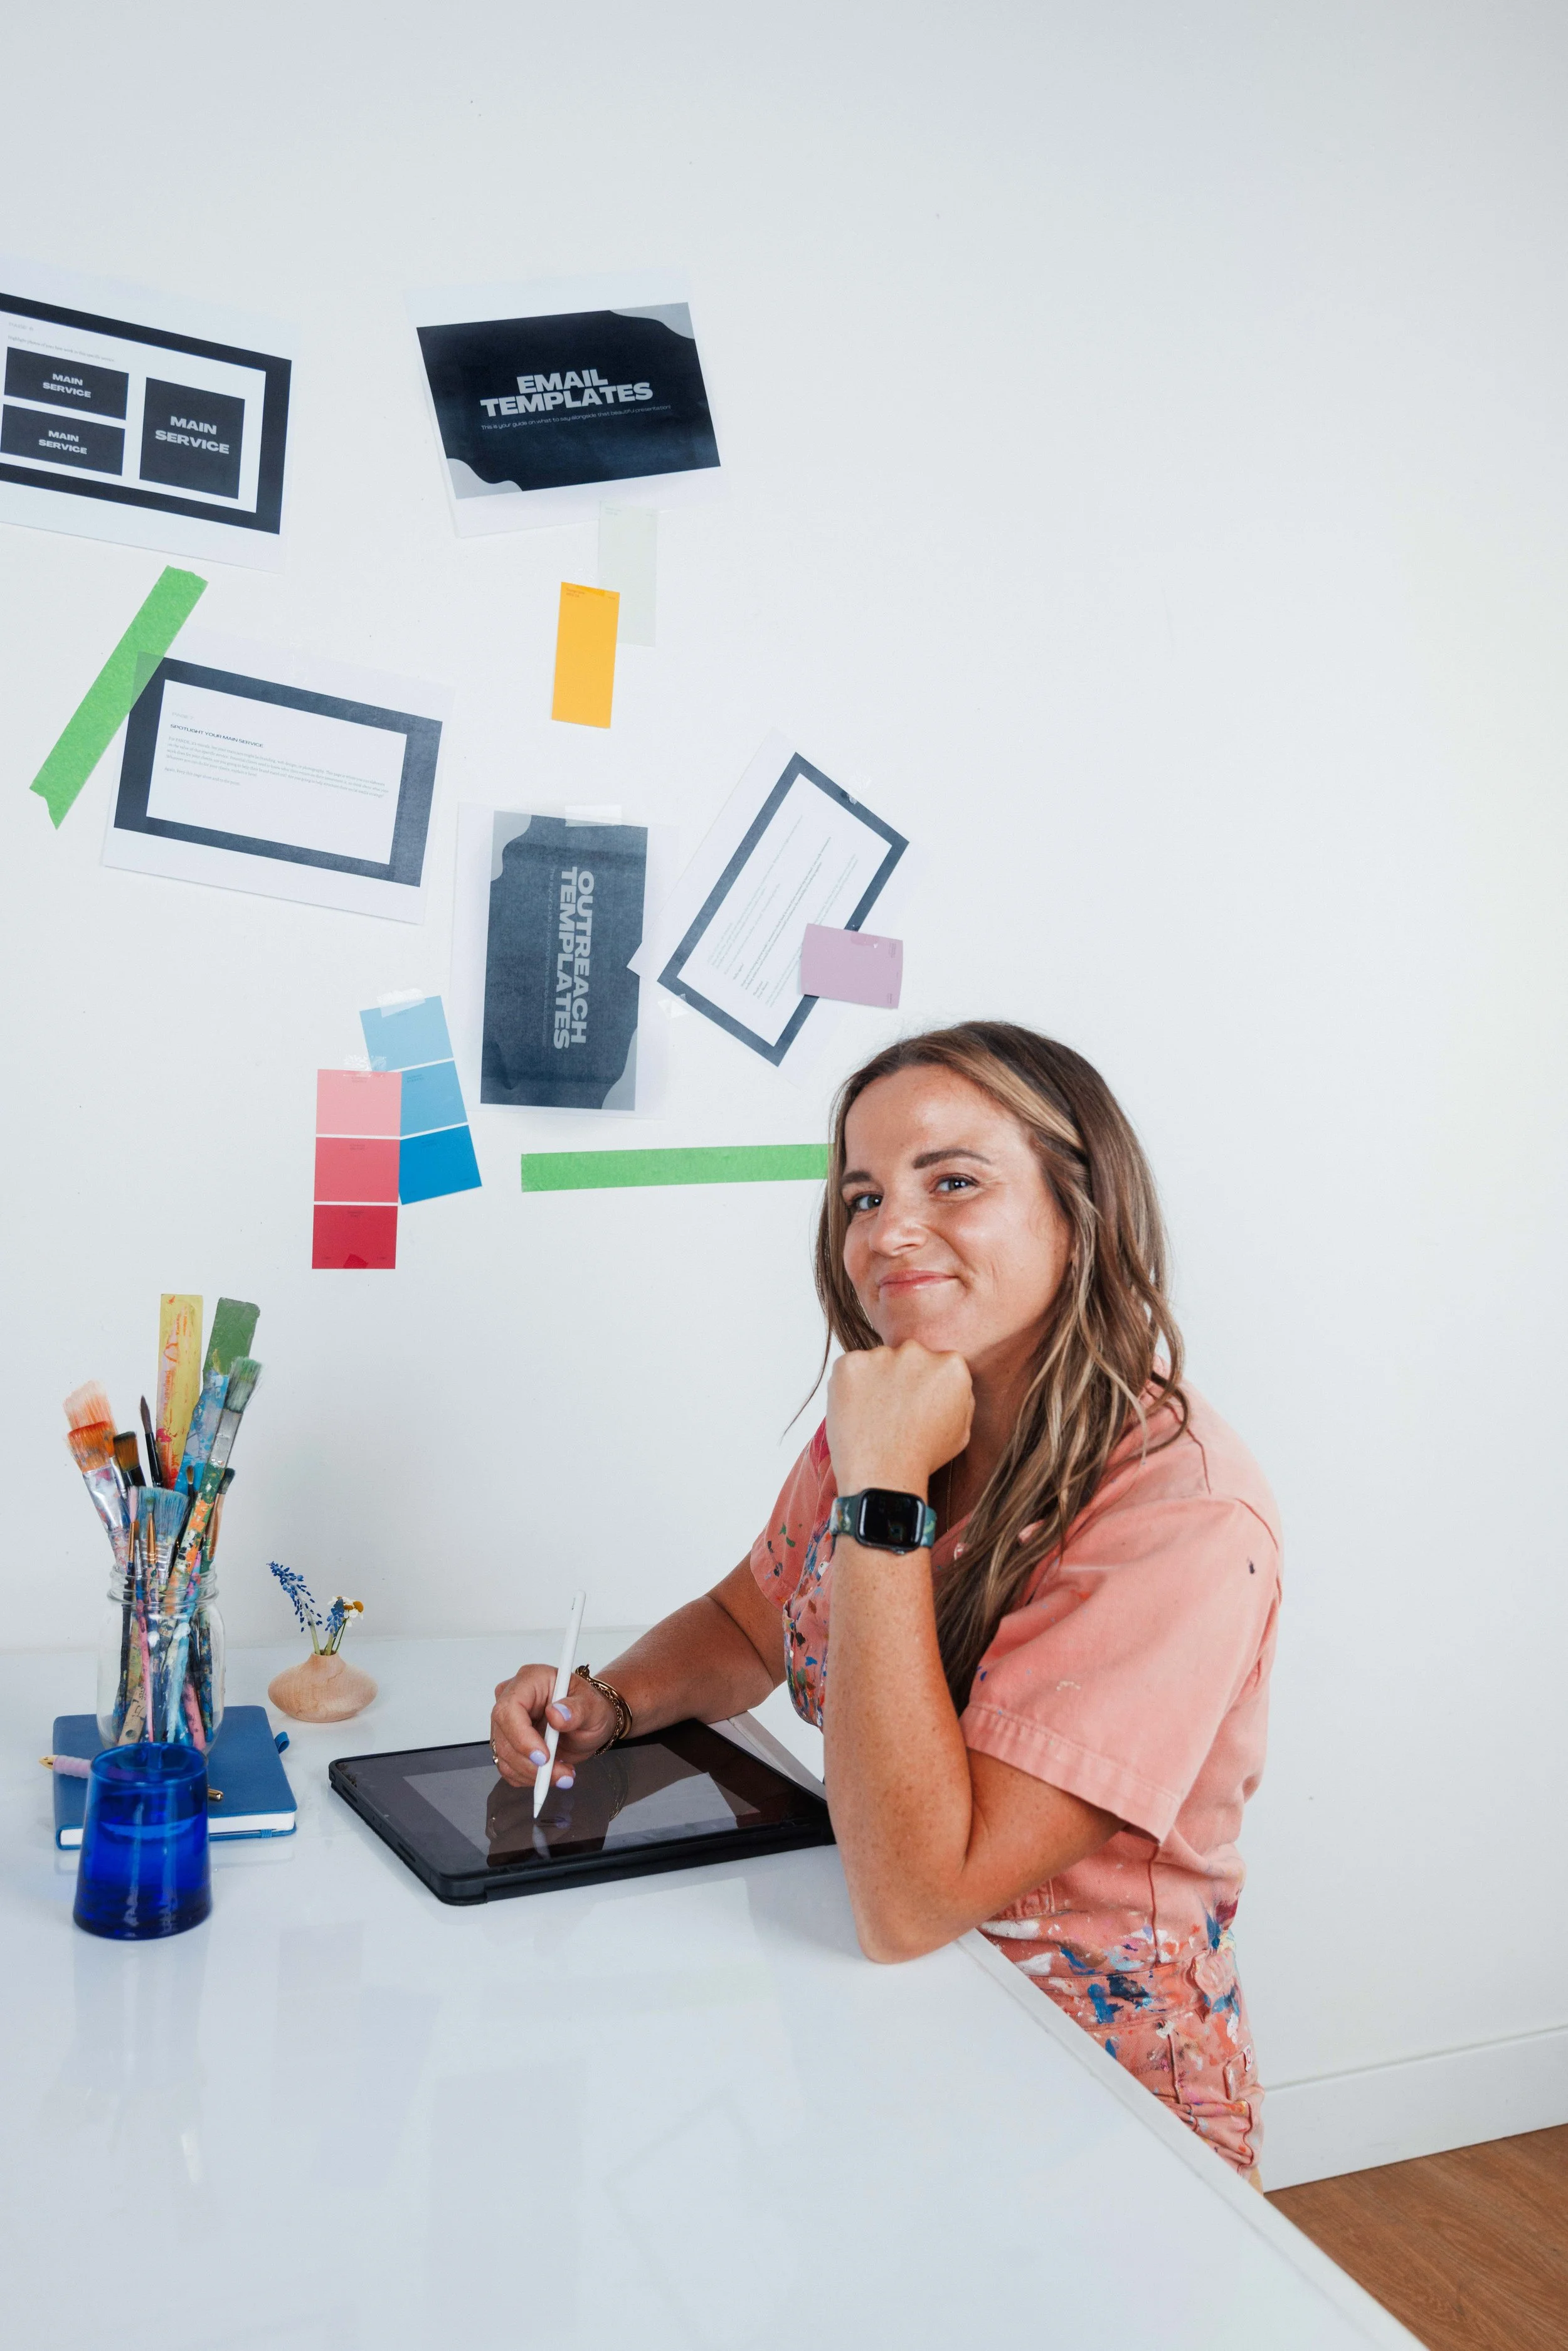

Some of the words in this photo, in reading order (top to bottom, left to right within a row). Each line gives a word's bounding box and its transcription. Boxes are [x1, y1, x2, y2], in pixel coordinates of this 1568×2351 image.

[43, 382, 92, 398] SERVICE
[52, 373, 83, 386] MAIN
[516, 368, 608, 394] EMAIL
[480, 382, 654, 418] TEMPLATES
[170, 416, 217, 435] MAIN
[571, 413, 597, 421] alongside
[48, 430, 79, 442] MAIN
[155, 430, 230, 454] SERVICE
[38, 439, 87, 455] SERVICE
[170, 724, 203, 735] SPOTLIGHT
[238, 739, 263, 748] SERVICE
[553, 866, 578, 1049] TEMPLATES
[570, 870, 595, 1044] OUTREACH
